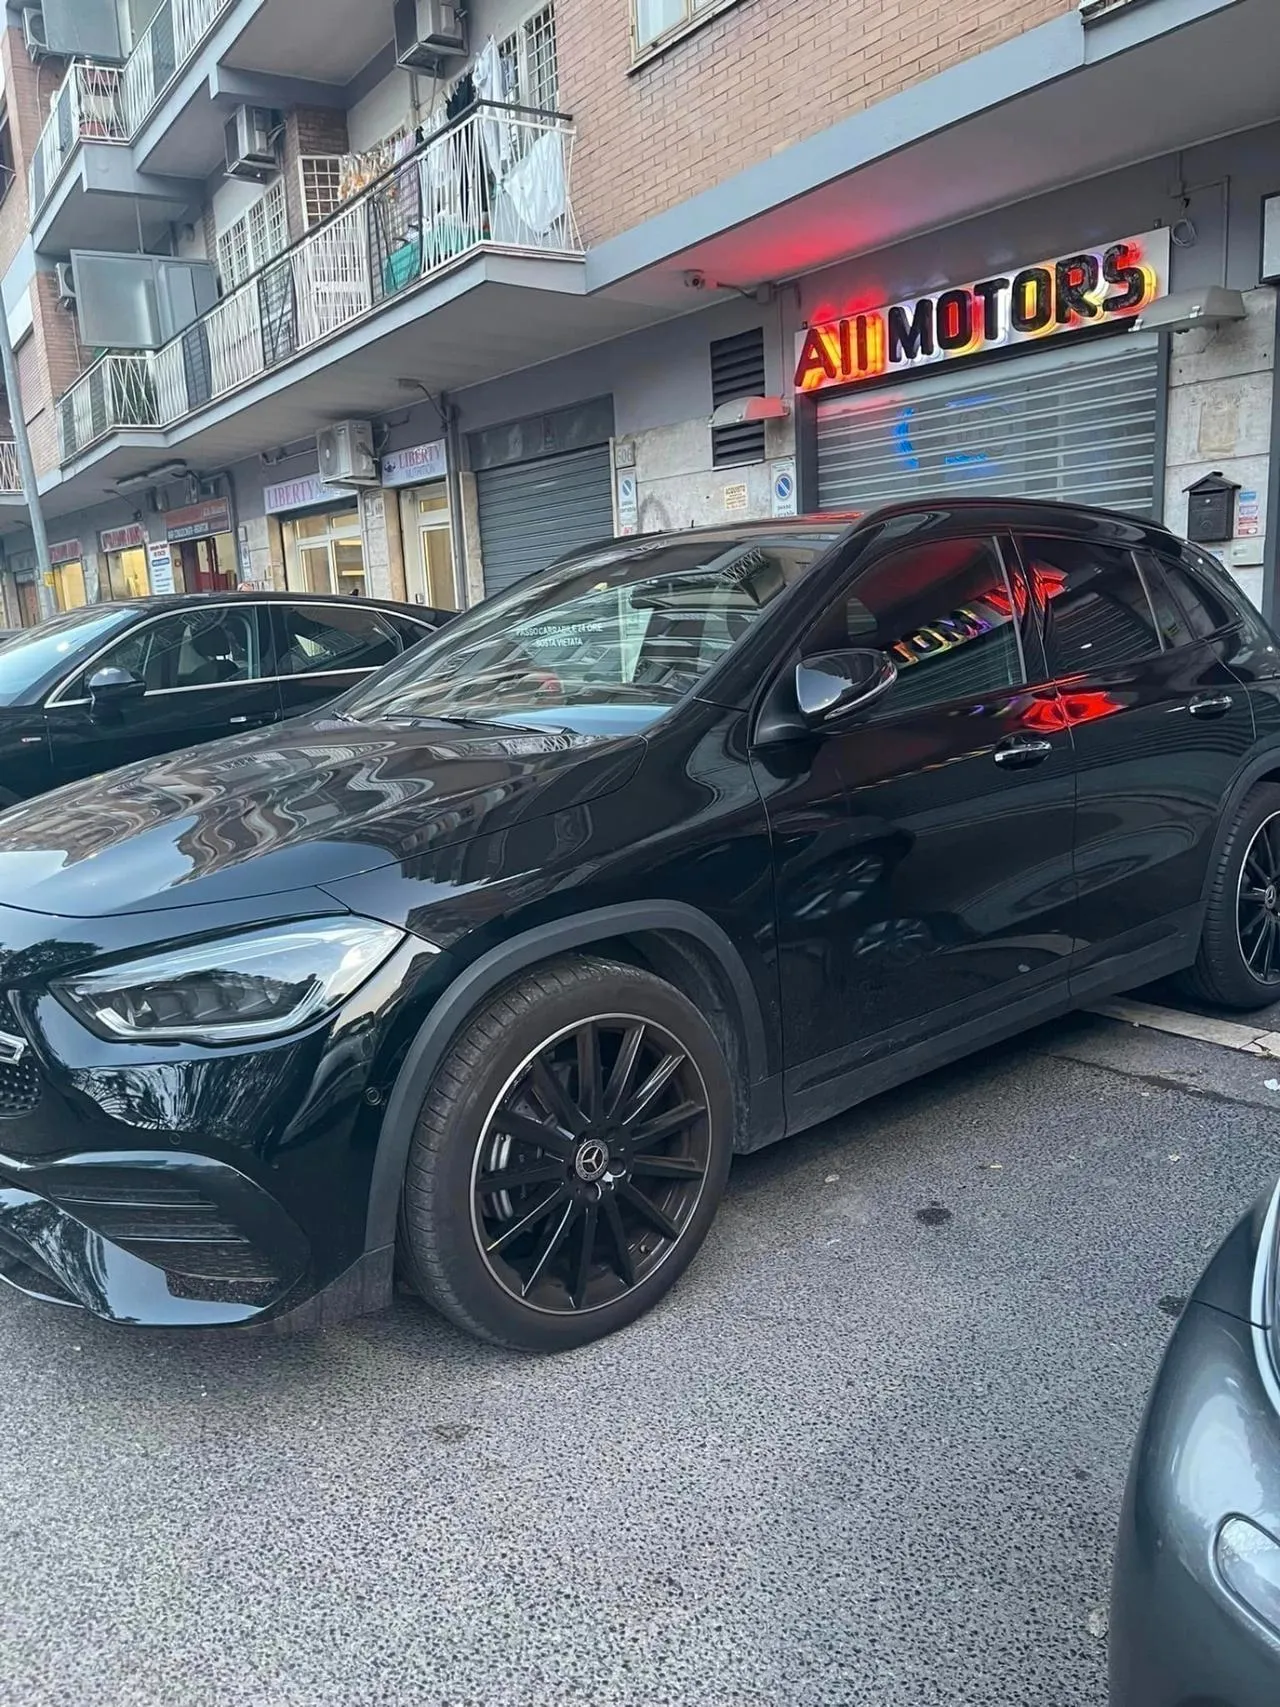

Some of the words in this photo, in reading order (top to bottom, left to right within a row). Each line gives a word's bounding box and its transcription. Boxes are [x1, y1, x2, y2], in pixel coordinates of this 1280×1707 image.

[888, 244, 1149, 363] MOTORS
[399, 444, 441, 468] LIBERTY
[267, 479, 314, 510] LIBERTY
[586, 623, 604, 632] ORE
[557, 638, 583, 646] VIETATA
